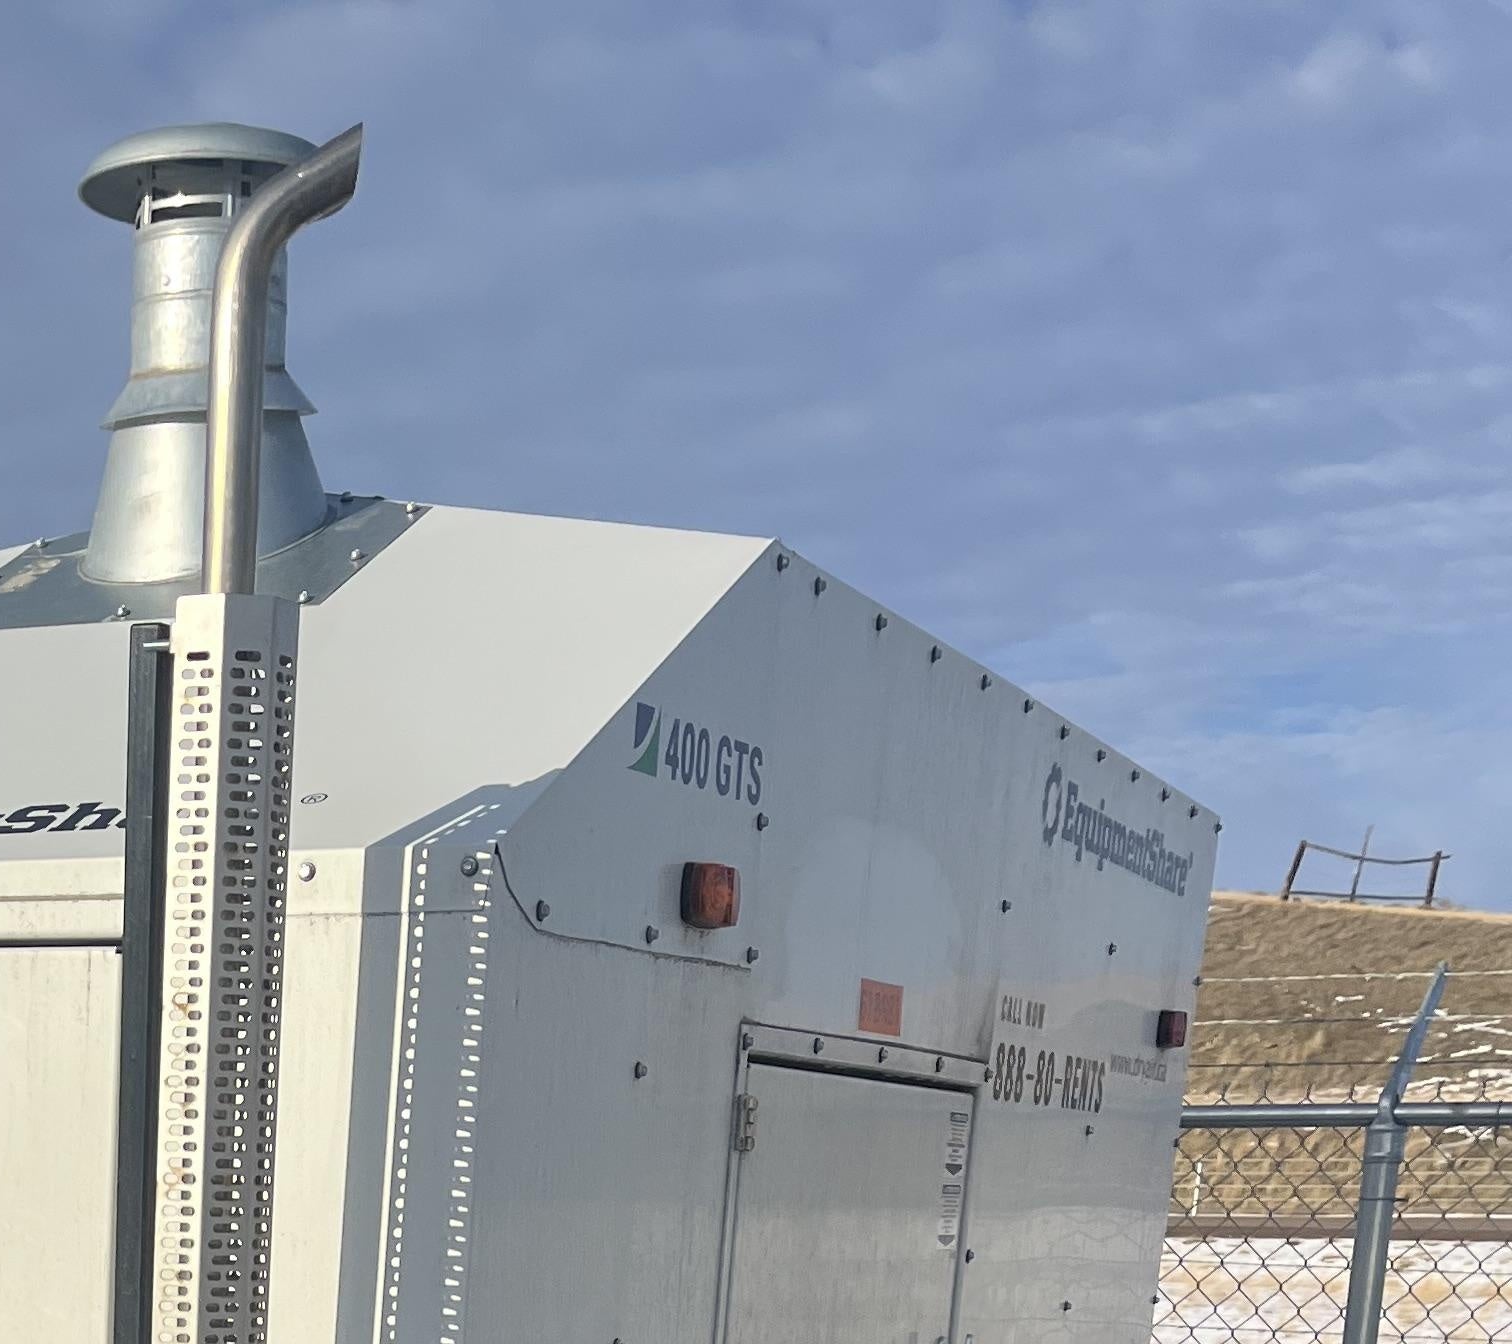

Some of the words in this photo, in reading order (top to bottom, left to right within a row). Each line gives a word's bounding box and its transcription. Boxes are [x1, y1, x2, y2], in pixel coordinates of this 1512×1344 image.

[664, 718, 710, 789] 400
[716, 735, 763, 806] GTS
[1061, 780, 1189, 897] EquipmentShare
[1000, 994, 1023, 1025] CALL
[992, 1042, 1106, 1114] 888-80-RENTS
